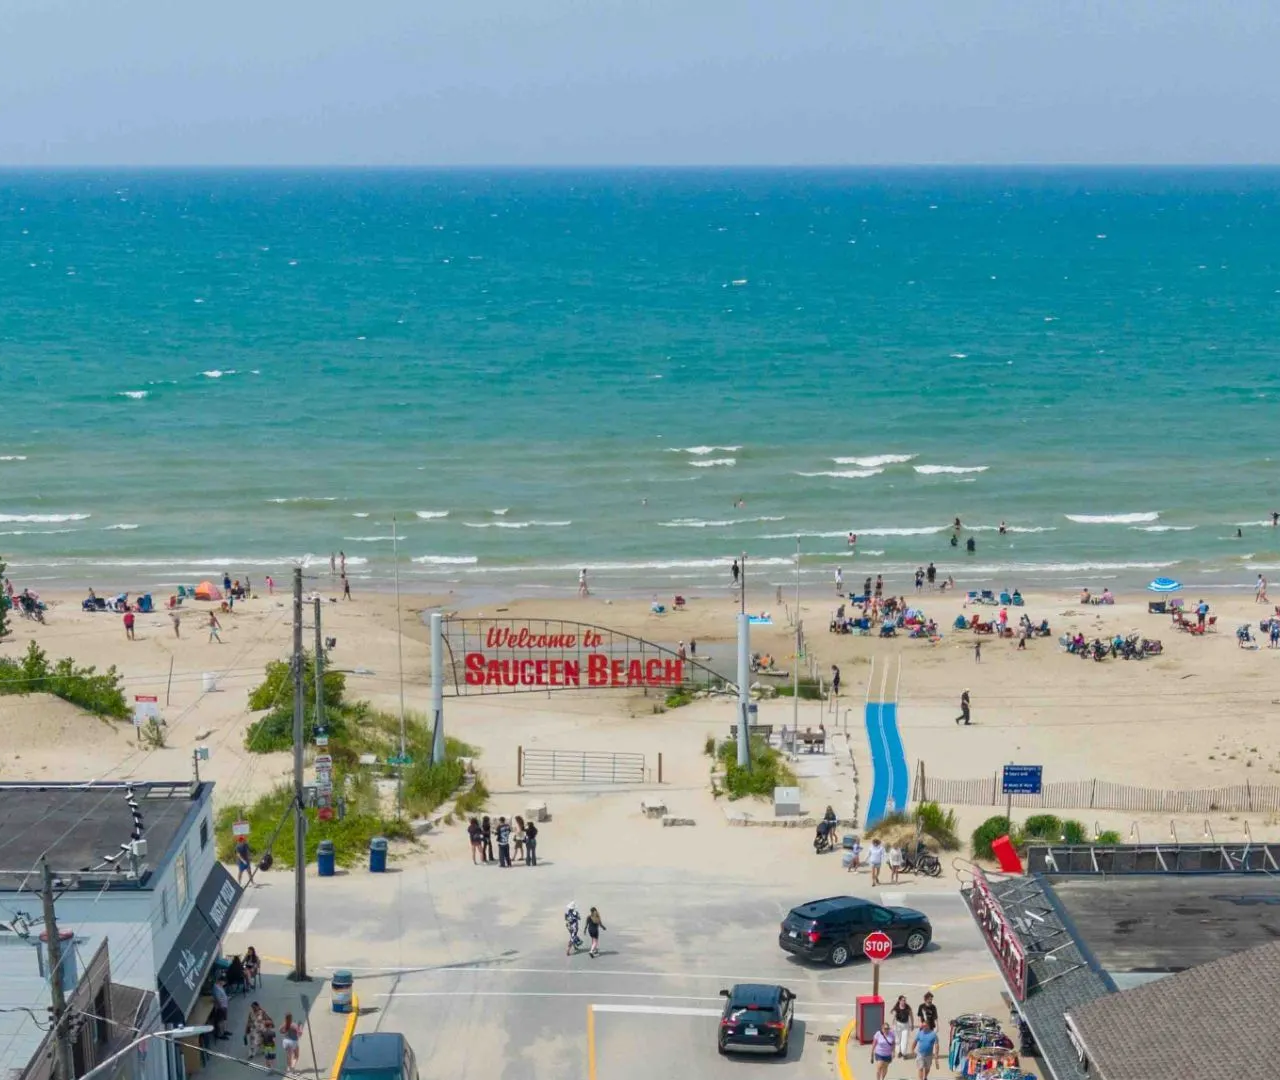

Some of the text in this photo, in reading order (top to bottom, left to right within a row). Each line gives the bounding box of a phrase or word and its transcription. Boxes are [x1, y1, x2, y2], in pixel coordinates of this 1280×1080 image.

[486, 627, 604, 649] Welcome to
[465, 652, 683, 687] SAUGEEN BEACH
[865, 940, 890, 952] STOP
